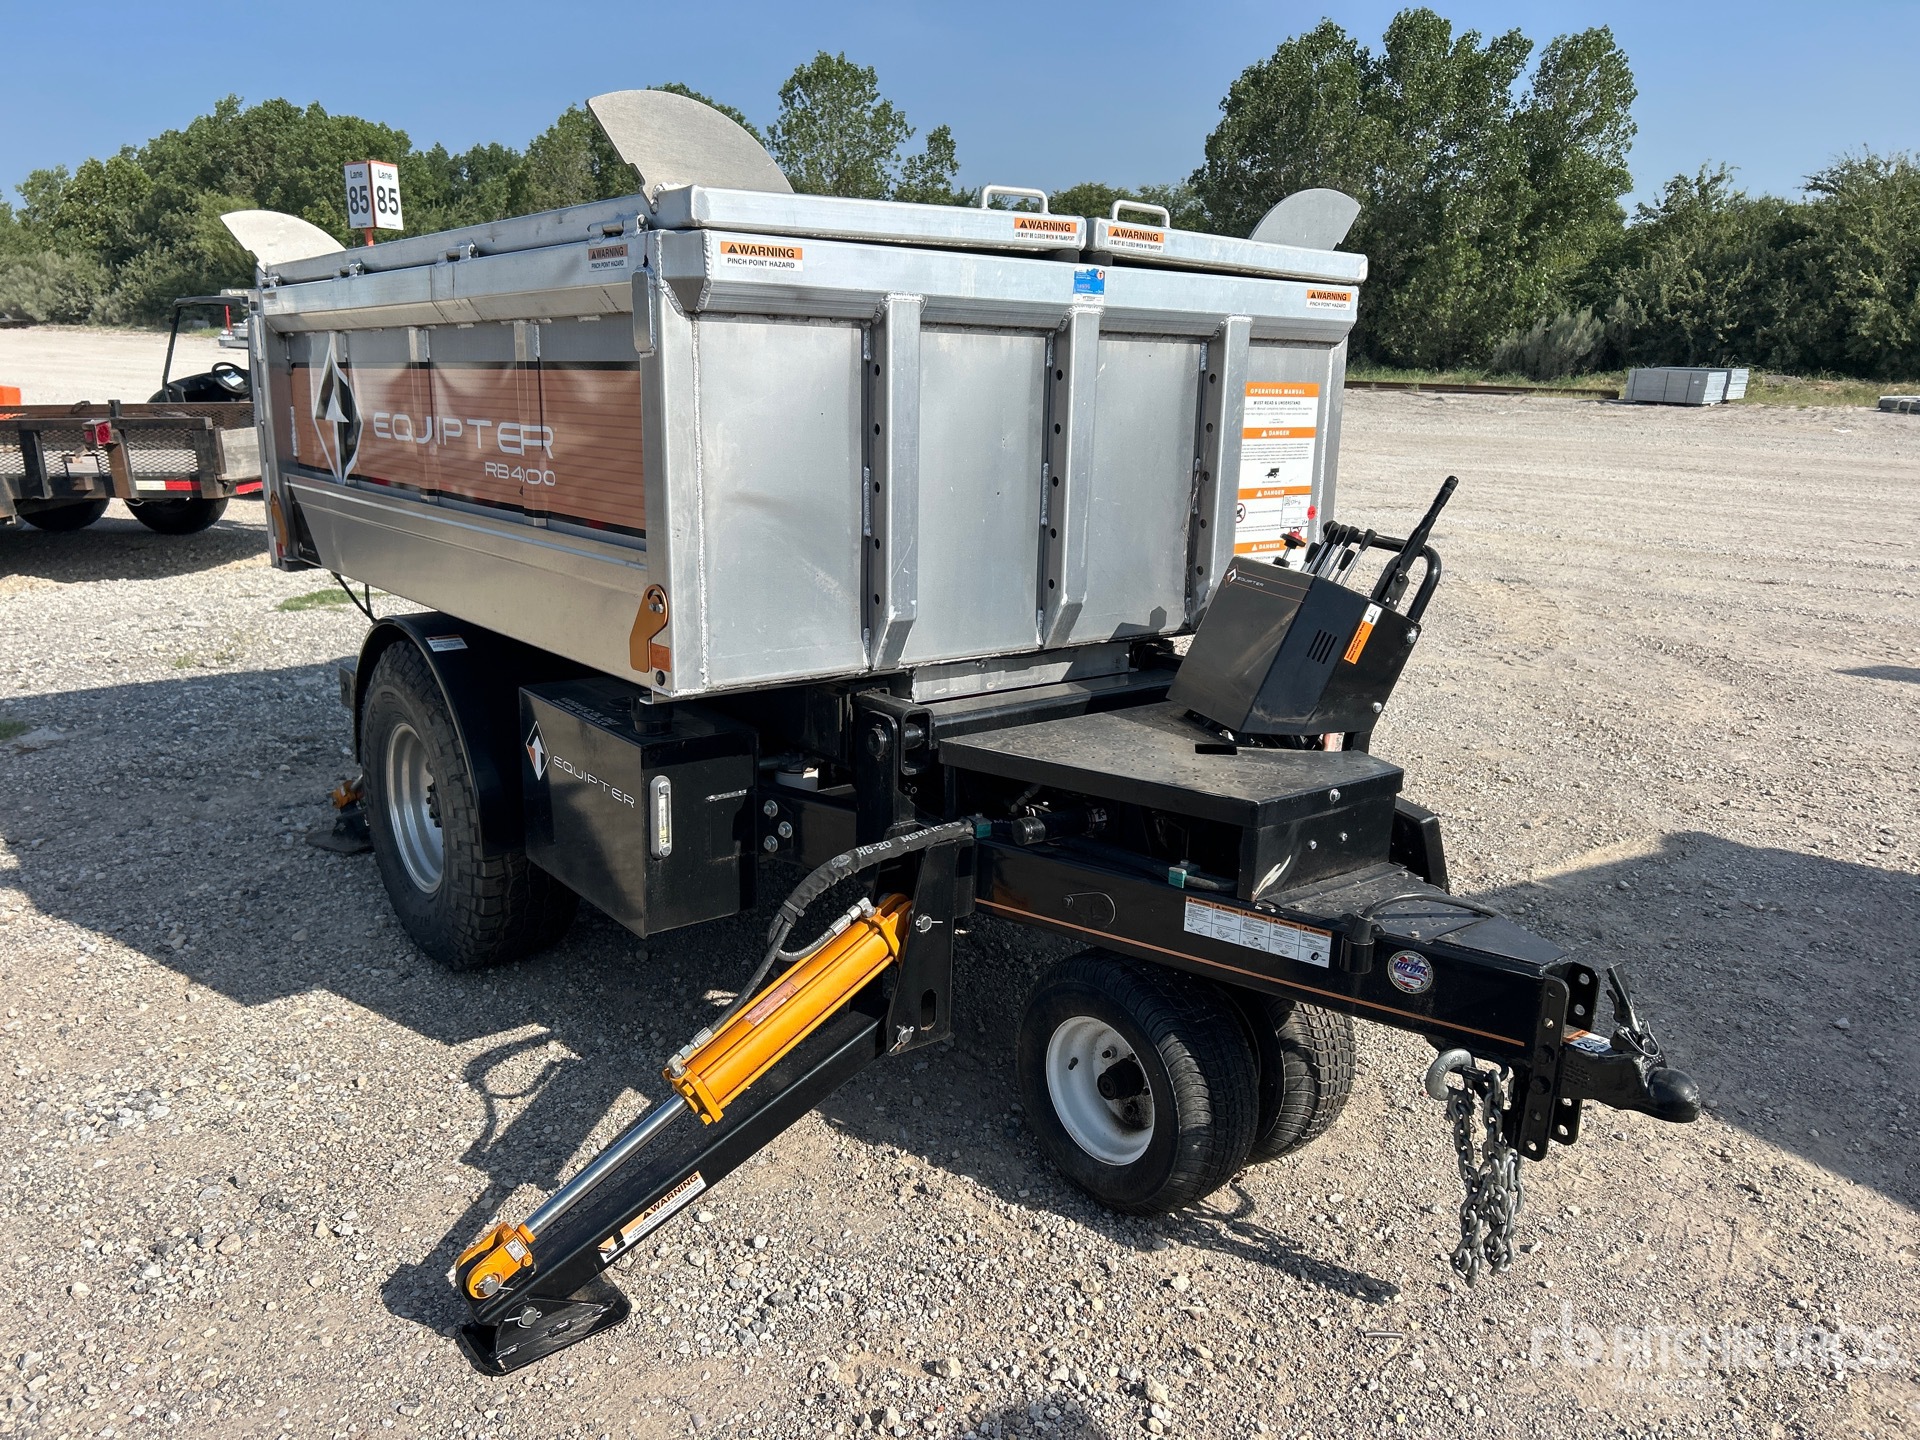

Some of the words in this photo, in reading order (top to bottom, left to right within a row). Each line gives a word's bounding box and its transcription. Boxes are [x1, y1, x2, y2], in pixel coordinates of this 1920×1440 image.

[349, 170, 363, 179] Lane
[377, 169, 393, 180] Lane
[349, 186, 370, 215] 85
[376, 186, 399, 216] 85
[1027, 220, 1071, 232] WARNING
[1120, 229, 1159, 242] WARNING
[595, 246, 624, 259] WARNING
[738, 244, 795, 259] WARNING
[727, 257, 747, 265] PINCH
[748, 259, 767, 267] POINT
[769, 261, 795, 269] HAZARD
[1316, 291, 1347, 301] WARNING
[372, 411, 554, 460] EQUIPTER
[553, 755, 635, 809] EQUIPTER
[855, 840, 892, 858] HG-20
[650, 1174, 699, 1213] WARNING
